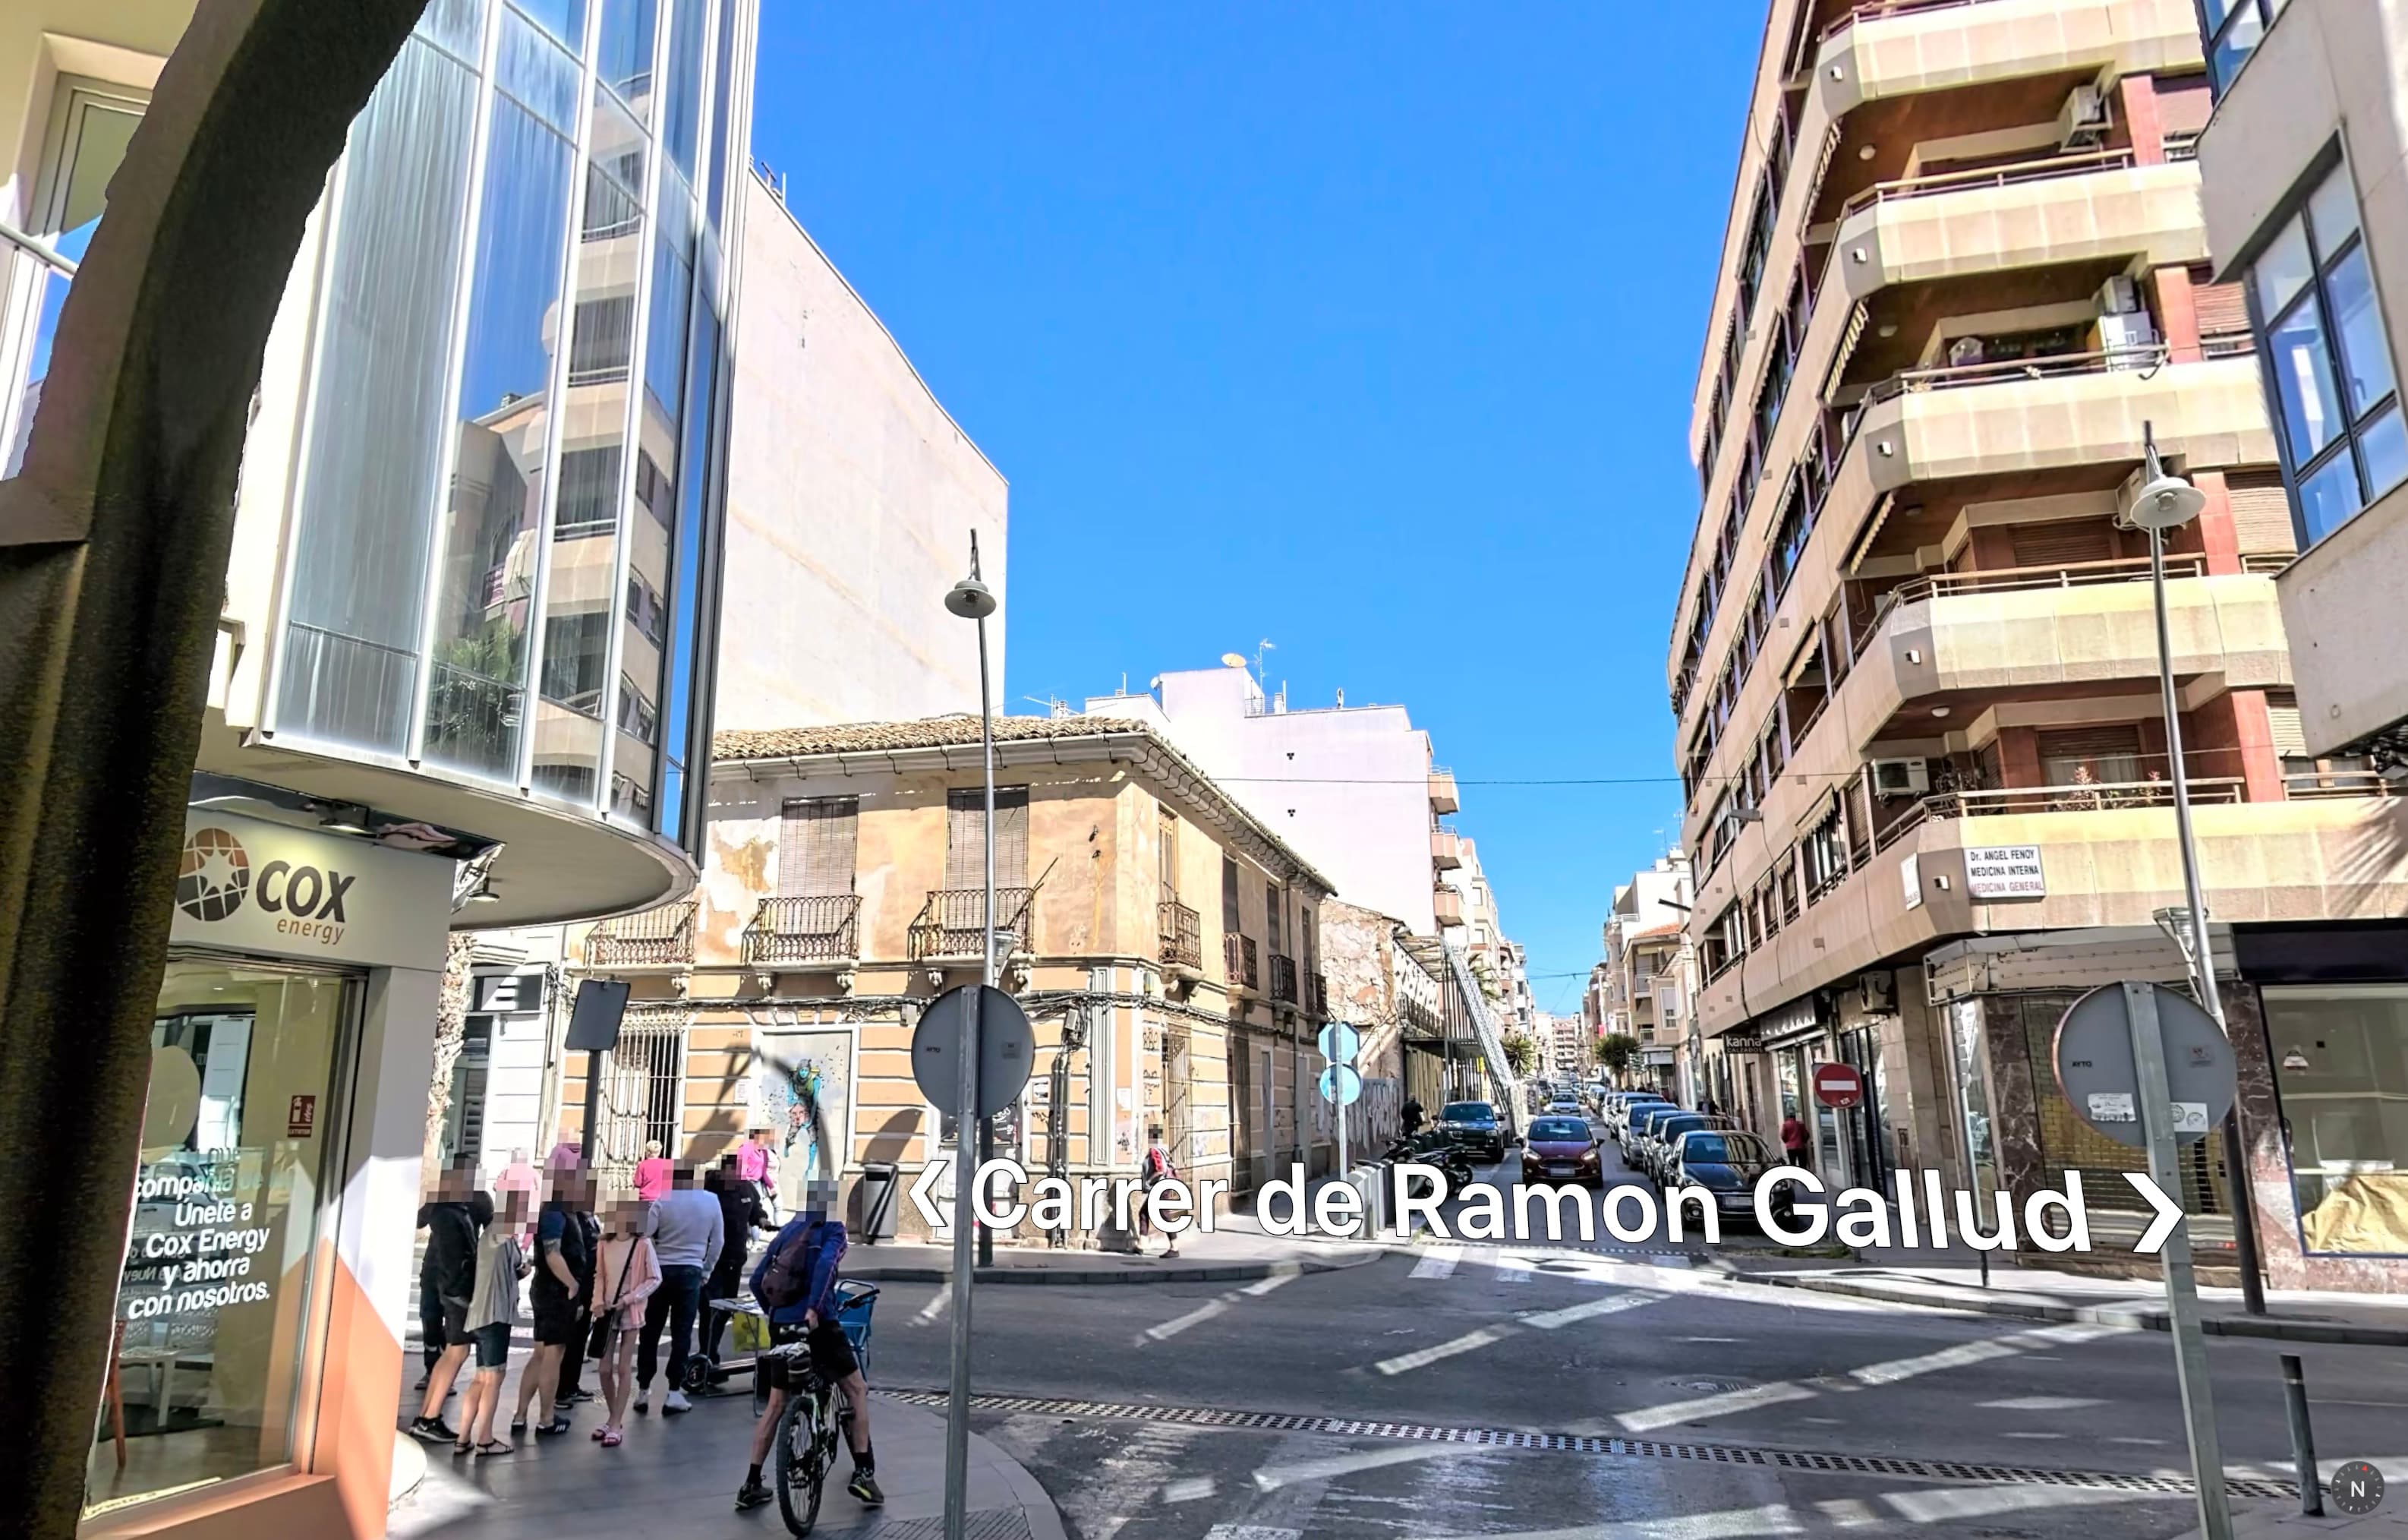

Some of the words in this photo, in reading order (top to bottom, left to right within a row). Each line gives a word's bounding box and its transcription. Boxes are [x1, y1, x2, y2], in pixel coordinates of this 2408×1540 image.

[1970, 851, 1981, 861] Dr.
[1984, 850, 2009, 860] ANGEL
[2011, 849, 2035, 859] FENOY
[1970, 866, 2006, 876] MEDICINA
[2008, 865, 2039, 876] INTERNA
[256, 860, 356, 923] COX
[1971, 882, 2006, 893] MEDICINA
[2009, 881, 2044, 891] GENERAL
[276, 918, 345, 945] energy
[1726, 1035, 1762, 1047] kanna
[175, 1198, 236, 1226] Únete
[240, 1202, 253, 1221] a
[146, 1232, 194, 1258] Cox
[198, 1227, 270, 1254] Energy
[162, 1264, 180, 1291] y
[183, 1256, 251, 1283] ahorra
[128, 1293, 172, 1319] con
[175, 1281, 270, 1312] nosotros.
